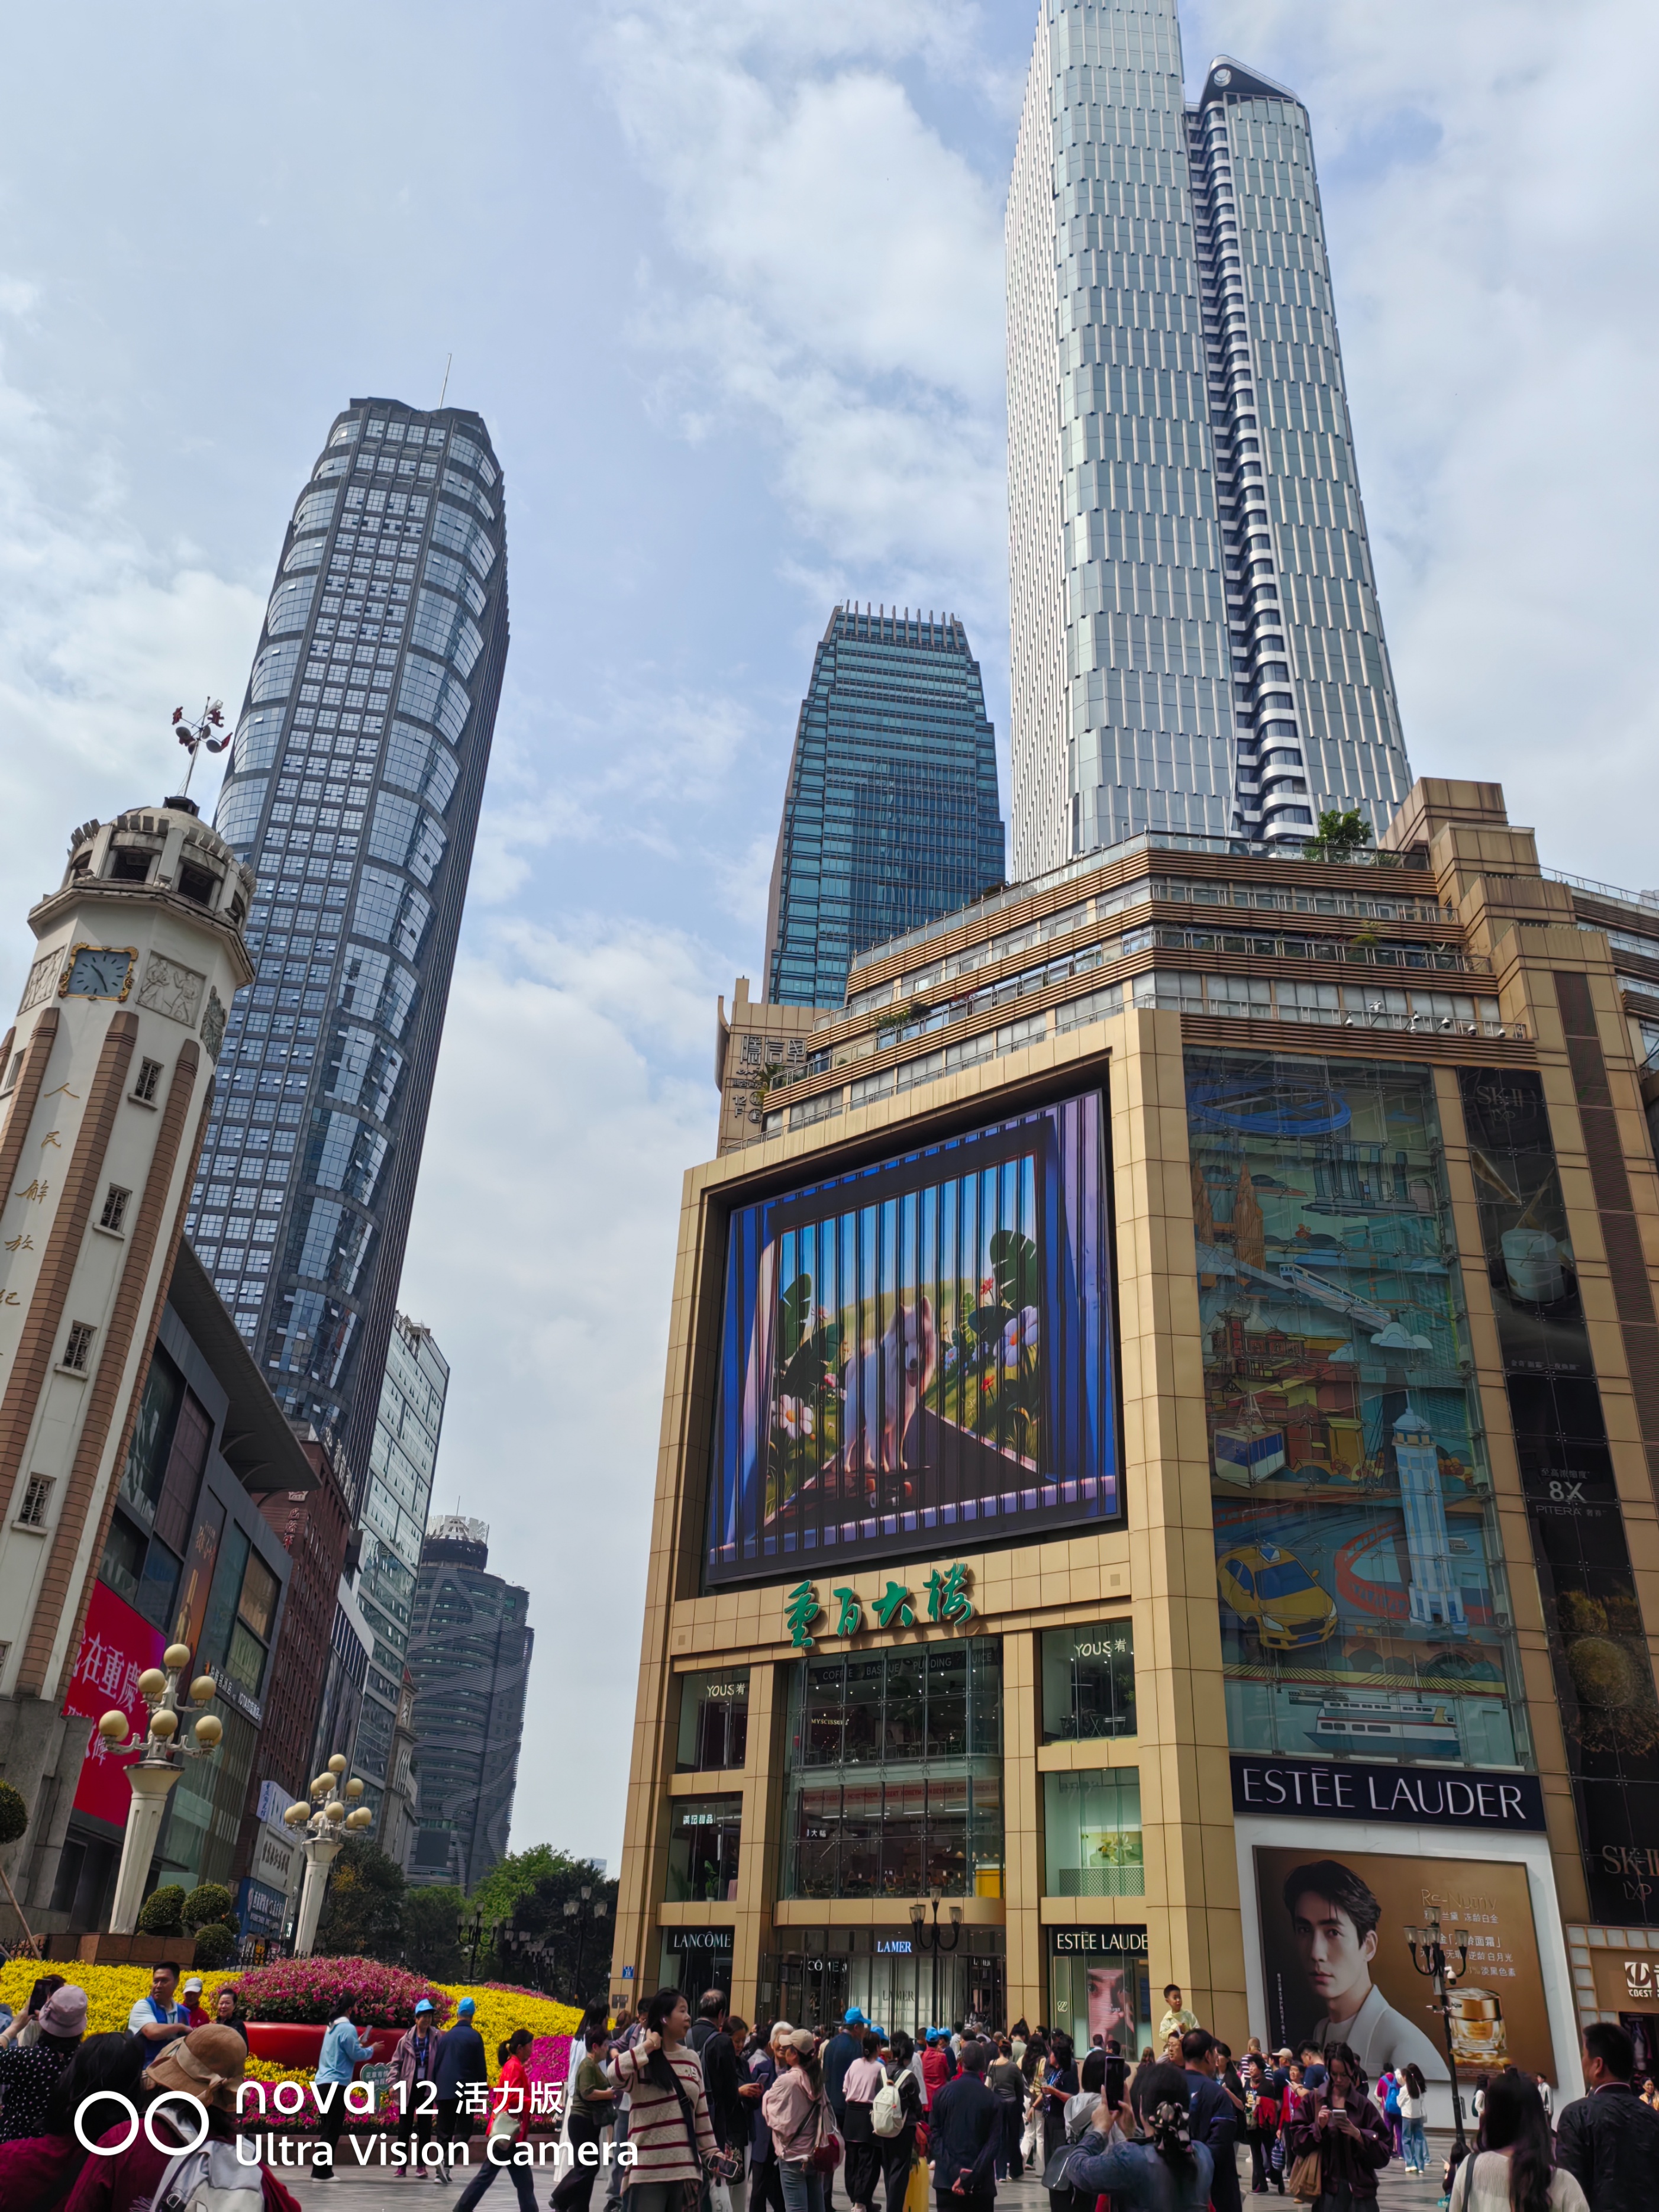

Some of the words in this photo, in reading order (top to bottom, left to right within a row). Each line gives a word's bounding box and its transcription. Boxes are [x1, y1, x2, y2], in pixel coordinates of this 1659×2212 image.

[732, 1094, 747, 1105] 12
[0, 1082, 80, 1356] 人民解放纪
[1549, 1481, 1587, 1503] 8X
[1536, 1505, 1581, 1515] PITERA
[784, 1562, 975, 1648] 重百大楼
[1074, 1640, 1112, 1658] YOUS
[913, 1658, 952, 1671] PUDING
[971, 1652, 992, 1663] UICE
[823, 1669, 853, 1680] COFFE
[866, 1663, 899, 1675] BASUE
[707, 1684, 735, 1697] YOUS
[1368, 1776, 1526, 1820] LAUDER
[674, 1931, 731, 1948] LANCÔME
[1101, 1933, 1148, 1950] LAUDE
